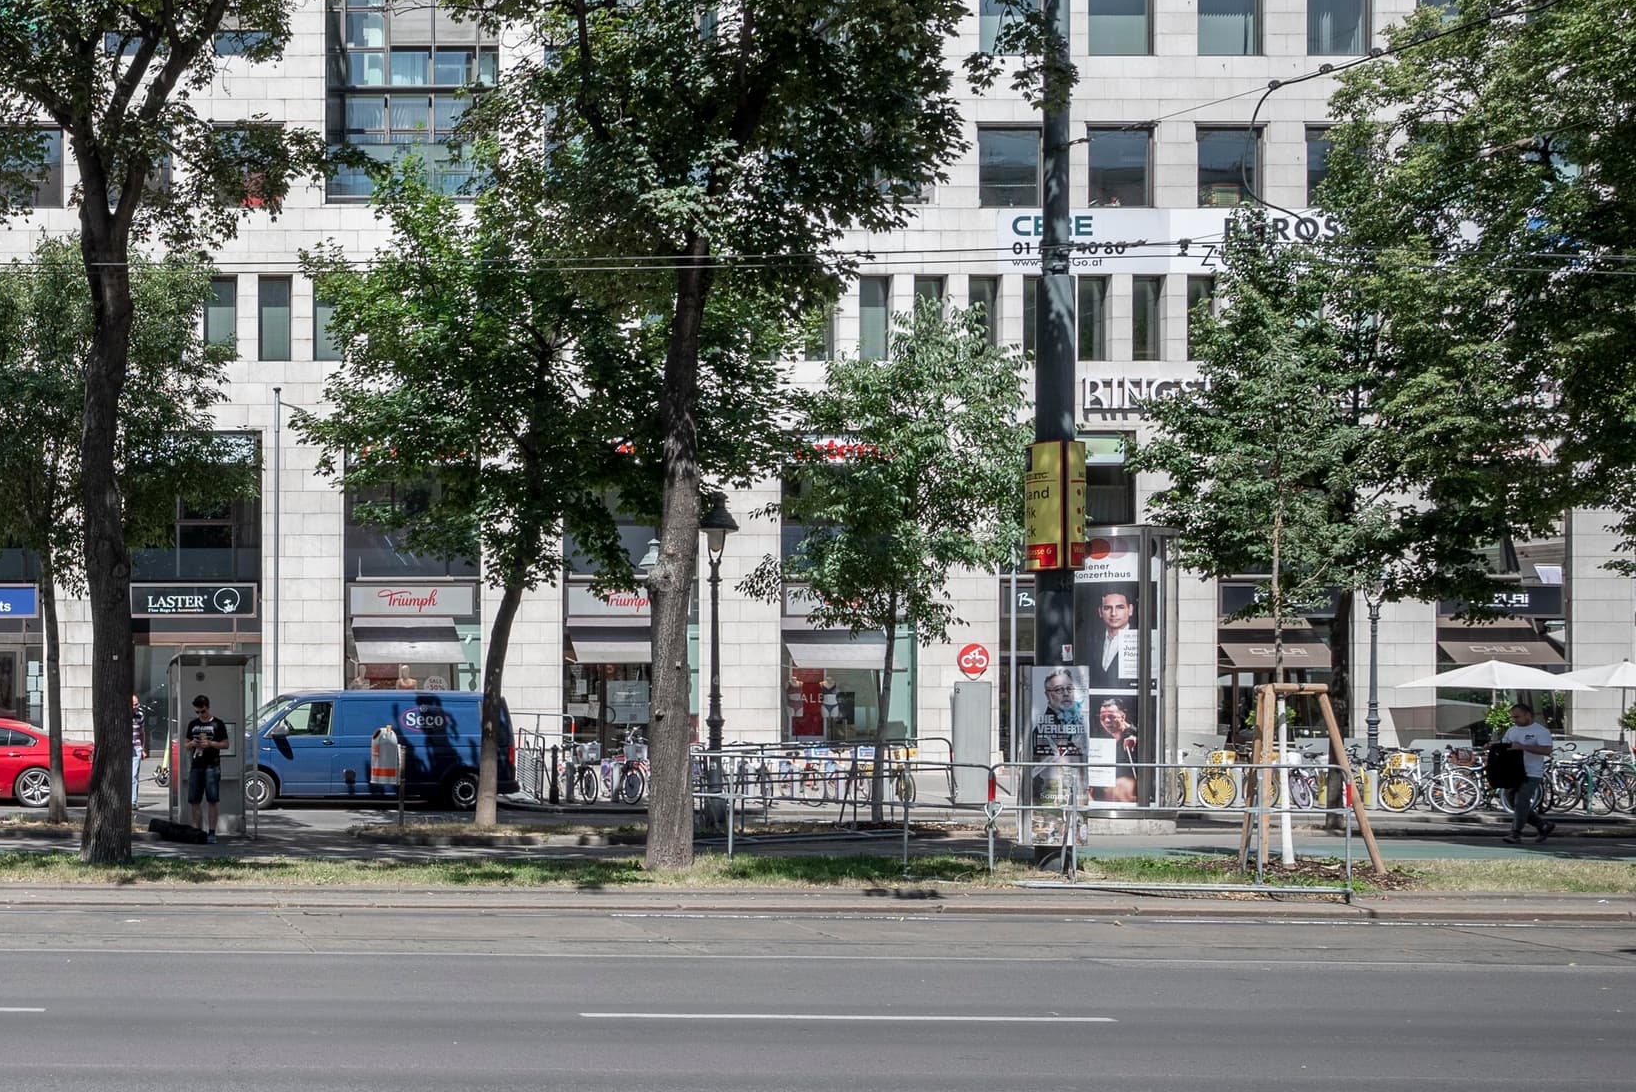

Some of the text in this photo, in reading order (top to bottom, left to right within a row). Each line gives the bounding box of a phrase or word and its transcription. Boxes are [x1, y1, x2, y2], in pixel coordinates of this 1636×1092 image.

[1012, 242, 1030, 255] 01
[147, 595, 205, 608] LASTER
[377, 588, 438, 613] Triumph
[801, 693, 823, 704] ALE
[405, 712, 444, 727] Seco
[1037, 714, 1054, 724] DIE
